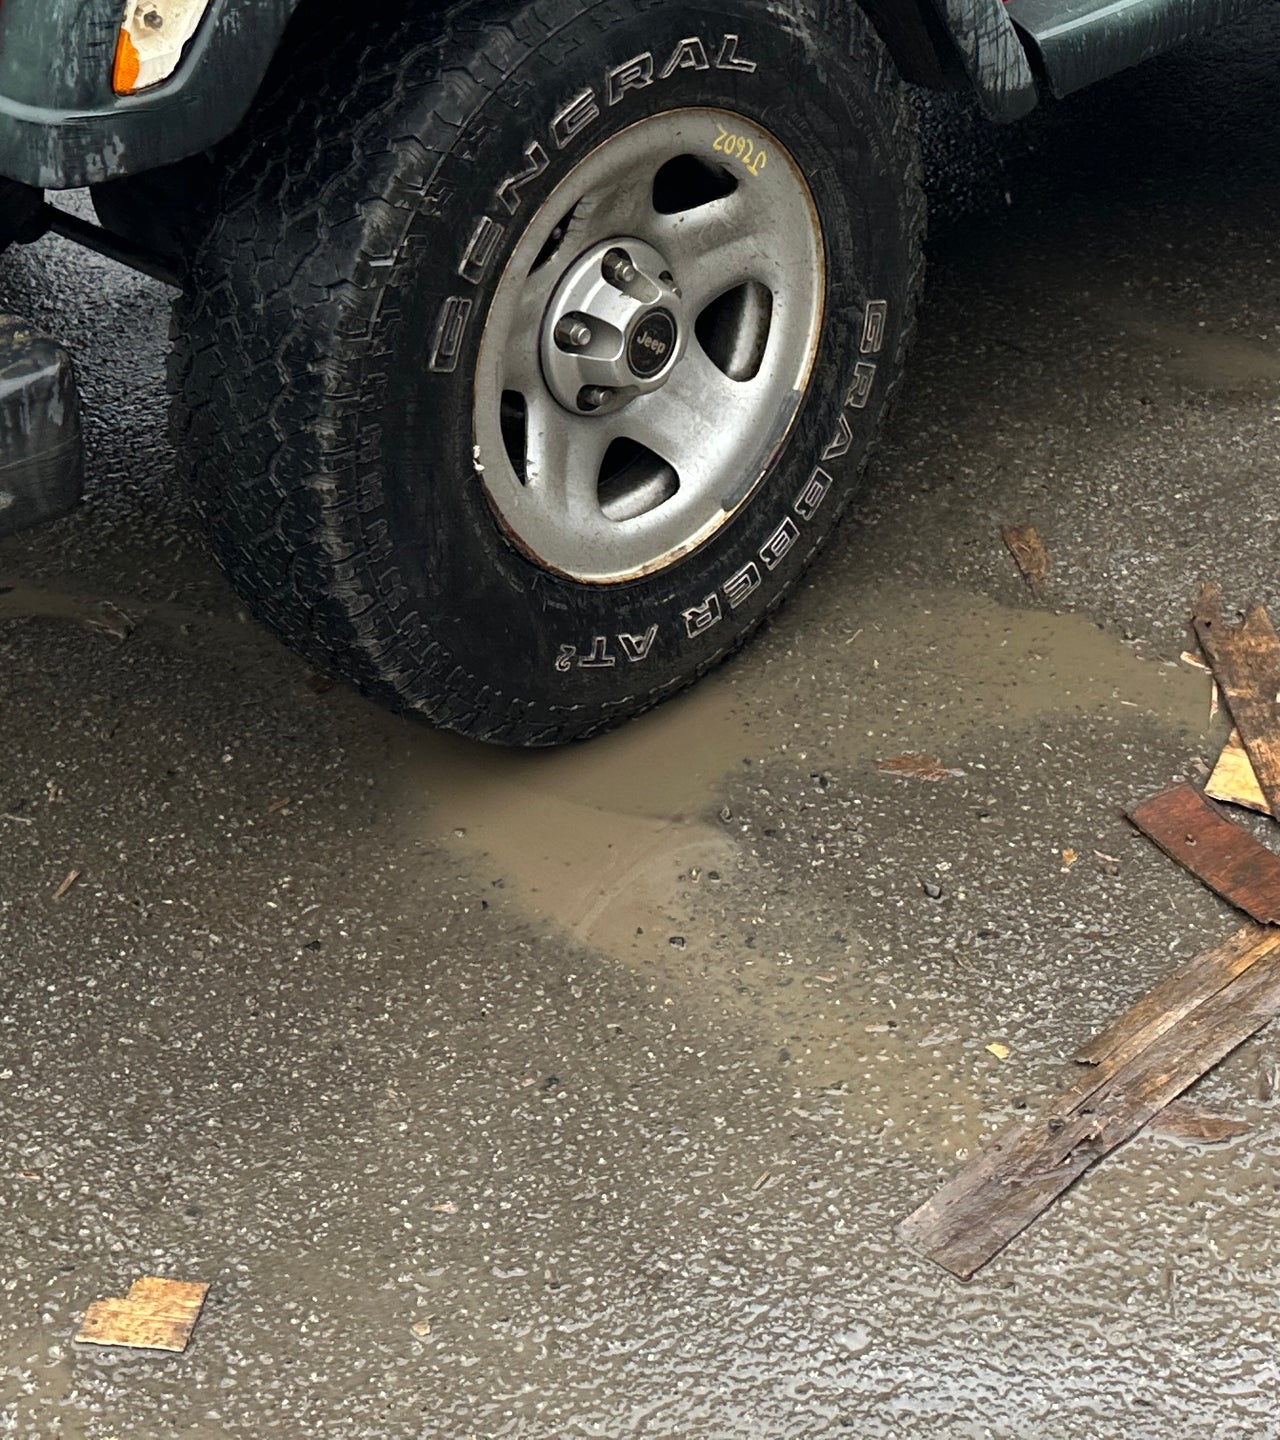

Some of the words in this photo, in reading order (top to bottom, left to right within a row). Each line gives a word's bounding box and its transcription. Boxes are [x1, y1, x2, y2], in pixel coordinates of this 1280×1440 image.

[428, 34, 757, 374] GENERAL
[636, 330, 666, 356] Jeep
[680, 299, 888, 639] GRABBER
